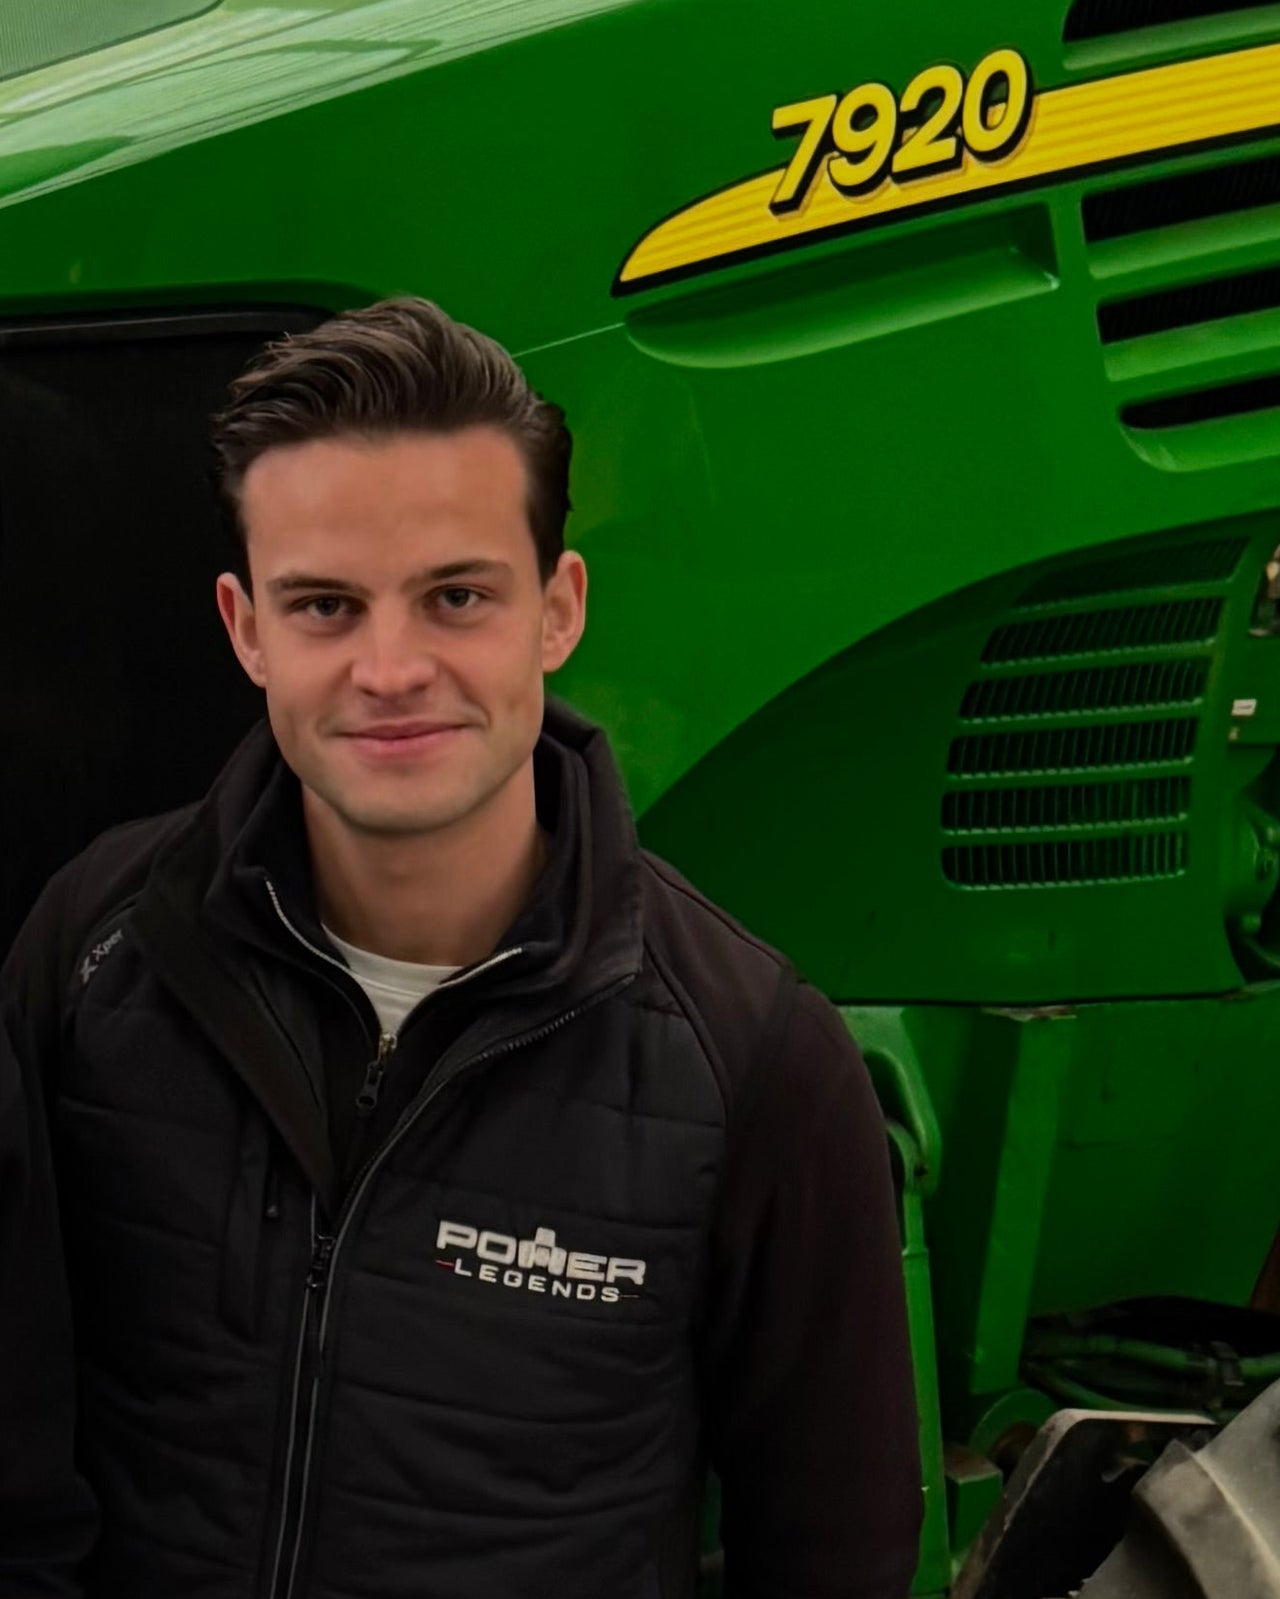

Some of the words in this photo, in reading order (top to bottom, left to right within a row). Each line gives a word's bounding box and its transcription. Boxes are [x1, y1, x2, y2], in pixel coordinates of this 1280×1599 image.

[770, 48, 1030, 212] 7920
[436, 1220, 646, 1286] POWER
[454, 1258, 620, 1302] LEGENDS
